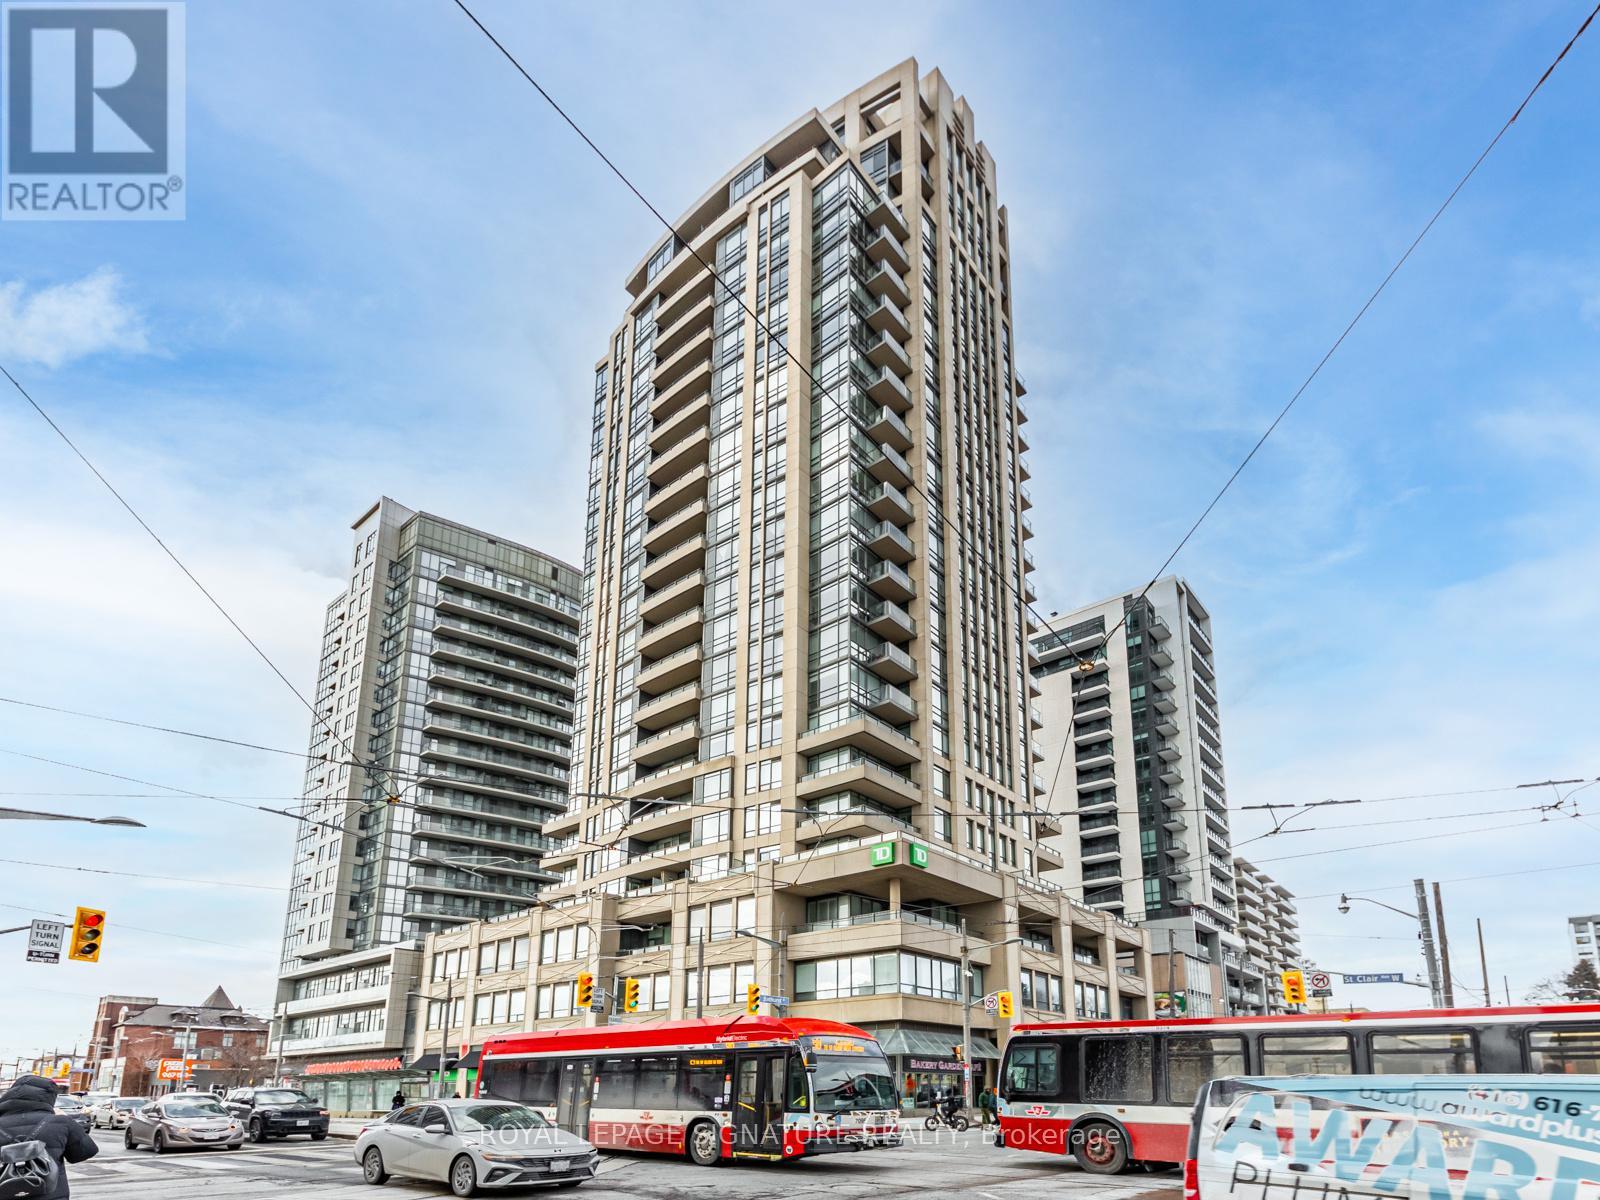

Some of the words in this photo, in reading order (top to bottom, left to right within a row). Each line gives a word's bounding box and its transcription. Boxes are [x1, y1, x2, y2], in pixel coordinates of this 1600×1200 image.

[873, 847, 890, 861] TD
[914, 847, 927, 863] TD
[36, 923, 59, 931] LEFT
[35, 931, 59, 940] TURN
[31, 939, 59, 949] SIGNAL
[1344, 975, 1353, 983] St
[1356, 975, 1378, 983] Clair
[1391, 974, 1400, 982] W
[910, 1059, 938, 1070] BAKERY
[938, 1060, 964, 1071] GARDE
